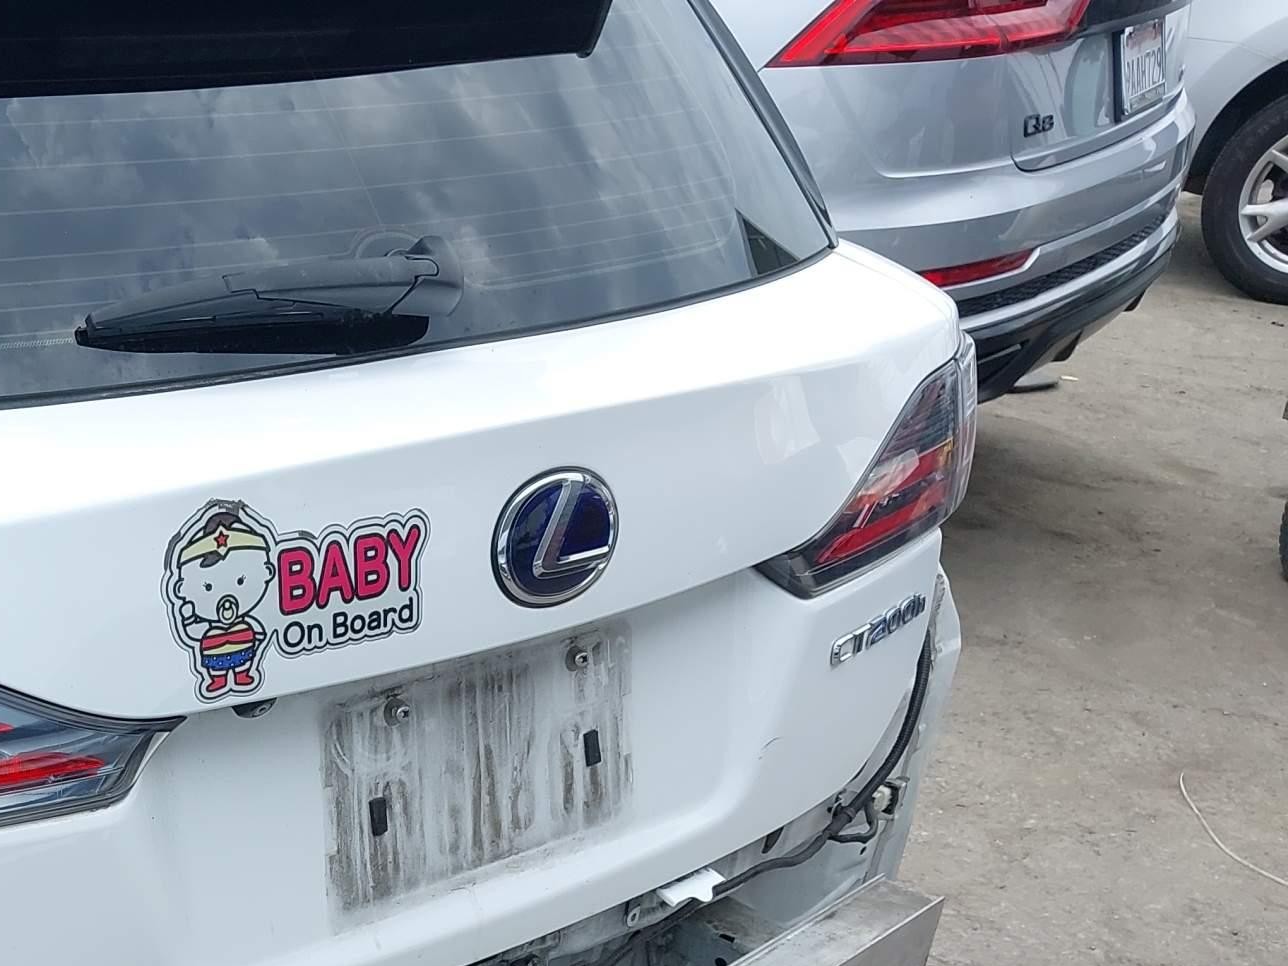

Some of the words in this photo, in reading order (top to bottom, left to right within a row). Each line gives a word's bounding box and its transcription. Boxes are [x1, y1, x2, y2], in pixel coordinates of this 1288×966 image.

[277, 524, 421, 616] BABY
[283, 621, 324, 648] On
[332, 597, 414, 639] Board
